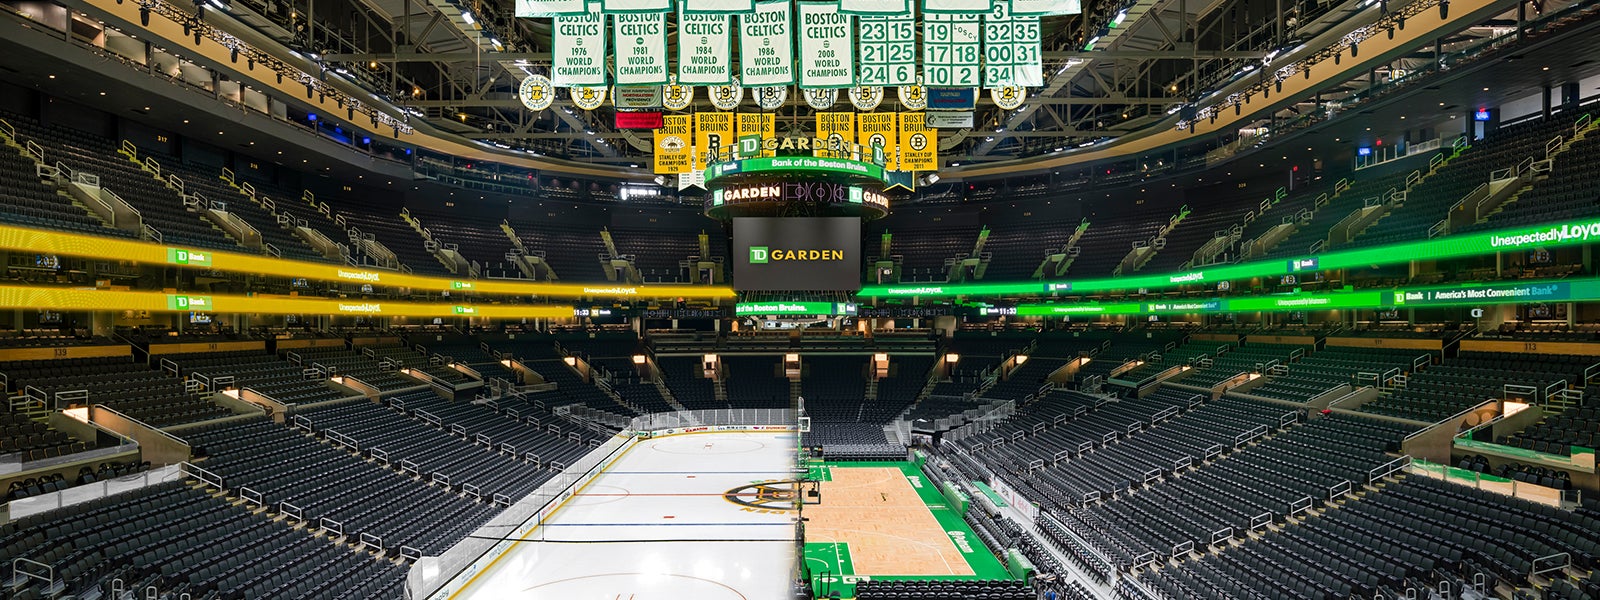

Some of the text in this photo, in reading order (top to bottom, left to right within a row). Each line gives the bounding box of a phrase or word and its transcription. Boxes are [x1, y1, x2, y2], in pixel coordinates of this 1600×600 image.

[558, 12, 600, 23] BOSTON
[618, 14, 660, 22] BOSTON
[683, 14, 725, 22] BOSTON
[742, 10, 785, 23] BOSTON
[805, 13, 847, 25] BOSTON
[560, 24, 599, 36] CELTICS
[620, 23, 659, 36] CELTICS
[685, 23, 724, 35] CELTICS
[746, 24, 785, 36] CELTICS
[806, 26, 846, 39] CELTICS
[862, 24, 885, 40] 23
[891, 23, 912, 40] 15
[928, 24, 948, 41] 19
[988, 24, 1010, 40] 32
[1015, 24, 1038, 41] 35
[572, 48, 587, 56] 1976
[633, 47, 648, 55] 1981
[696, 46, 712, 55] 1984
[758, 48, 775, 56] 1986
[818, 50, 835, 58] 2008
[864, 46, 884, 61] 21
[890, 44, 914, 61] 25
[928, 46, 948, 62] 17
[956, 46, 976, 62] 18
[988, 46, 1011, 62] 00
[1018, 46, 1037, 62] 31
[566, 58, 593, 66] WORLD
[628, 56, 655, 65] WORLD
[691, 56, 718, 65] WORLD
[754, 57, 781, 66] WORLD
[814, 60, 841, 68] WORLD
[558, 67, 601, 76] CHAMPIONS
[620, 66, 663, 75] CHAMPIONS
[682, 66, 725, 74] CHAMPIONS
[746, 66, 789, 76] CHAMPIONS
[806, 68, 848, 77] CHAMPIONS
[896, 66, 908, 82] 6
[862, 67, 886, 83] 24
[928, 68, 948, 84] 10
[960, 68, 972, 84] 2
[989, 68, 1011, 83] 34
[673, 88, 681, 97] 15
[722, 88, 730, 97] 9
[766, 87, 774, 97] 8
[819, 89, 825, 97] 7
[863, 88, 870, 98] 5
[912, 88, 919, 97] 4
[1005, 88, 1012, 97] 2
[664, 117, 687, 125] OSTON
[700, 114, 729, 123] BOSTON
[742, 115, 770, 123] BOSTON
[820, 114, 850, 123] BOSTON
[862, 114, 891, 123] BOSTON
[904, 115, 925, 123] BOST
[658, 126, 687, 135] BRUINS
[700, 123, 729, 132] BRUINS
[742, 124, 770, 132] BRUINS
[820, 124, 850, 132] BRUINS
[862, 124, 891, 132] BRUINS
[740, 138, 852, 153] TD GARDEN
[818, 160, 845, 169] Boston
[724, 186, 780, 201] GARDEN
[177, 252, 205, 262] TD Bank
[752, 250, 844, 261] TD GARDEN
[1396, 294, 1405, 303] TD
[1406, 292, 1423, 300] Bank
[1435, 290, 1466, 300] America's
[1468, 290, 1486, 298] Most
[1486, 288, 1531, 297] Convenient
[177, 298, 205, 307] TD Bank
[54, 349, 68, 357] 139
